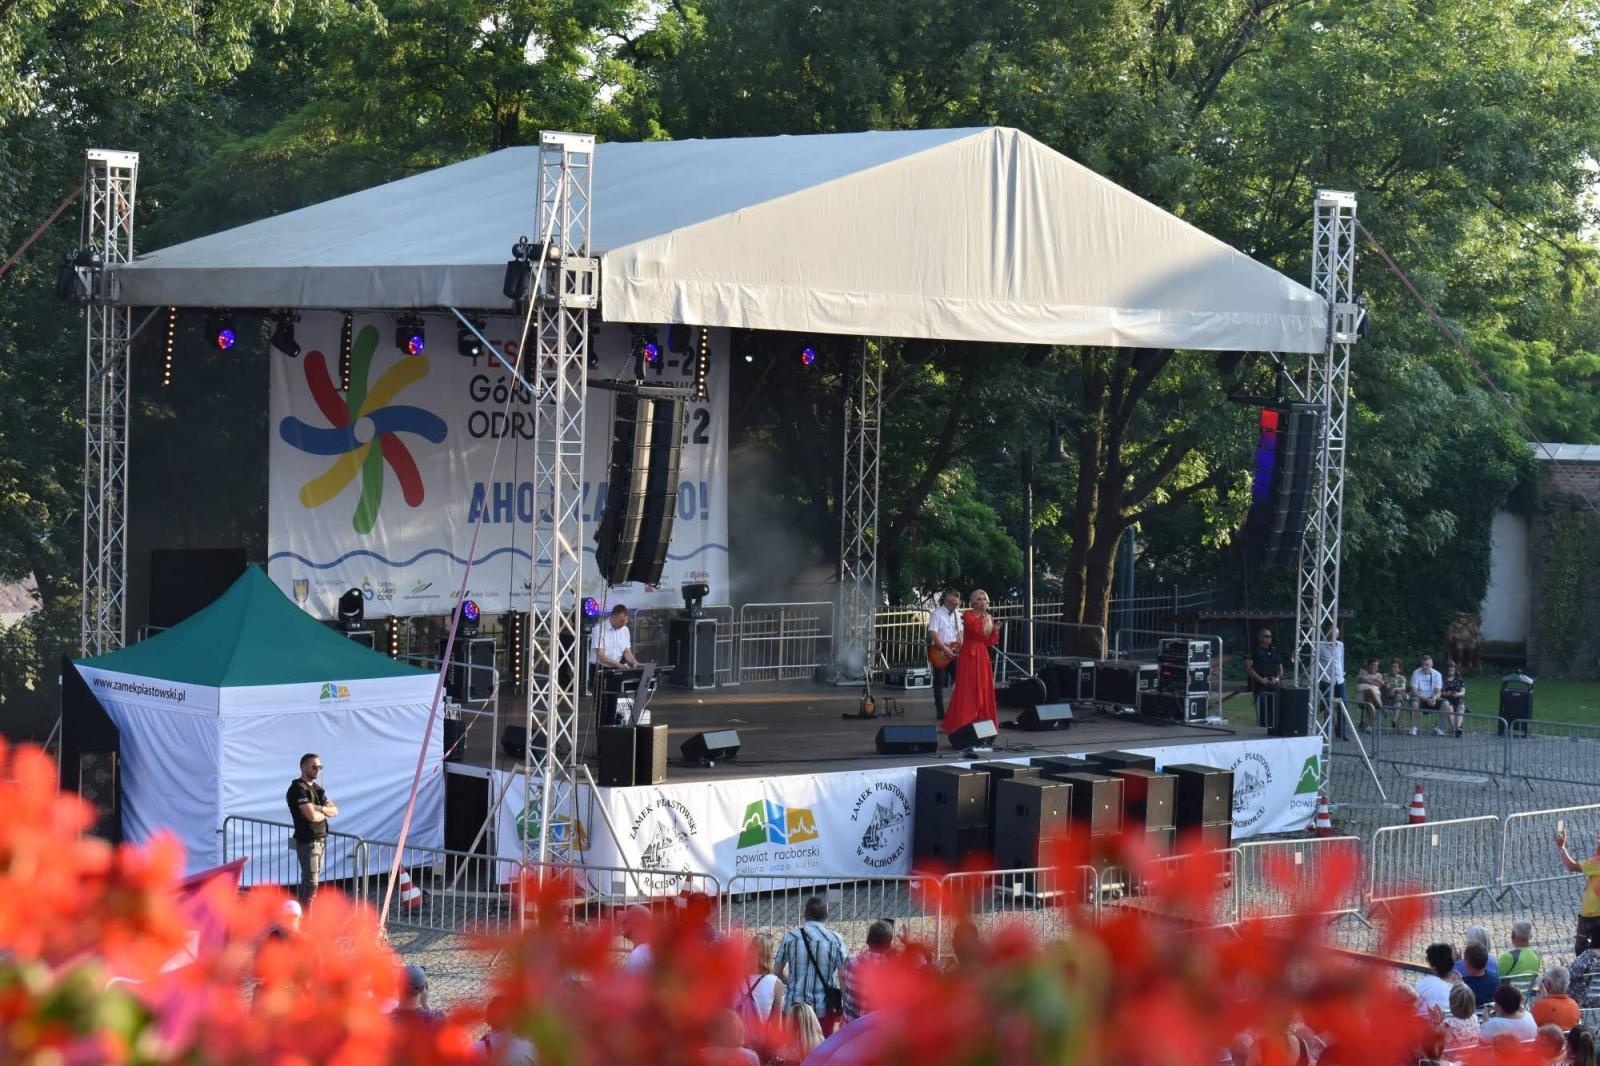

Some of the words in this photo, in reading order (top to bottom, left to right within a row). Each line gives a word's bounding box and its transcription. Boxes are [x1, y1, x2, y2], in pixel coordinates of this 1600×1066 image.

[93, 677, 186, 702] www.zamekpiastowski.pl
[1245, 752, 1272, 783] PIASTOWSKI
[851, 788, 872, 821] ZAMEK
[875, 783, 911, 816] PIASTOWSKI
[630, 804, 653, 839] ZAMEK
[657, 799, 697, 836] PIASTOWSKI
[736, 850, 768, 867] powiat
[770, 863, 790, 872] oaza
[857, 846, 864, 856] W
[864, 842, 905, 868] RACIBORZU
